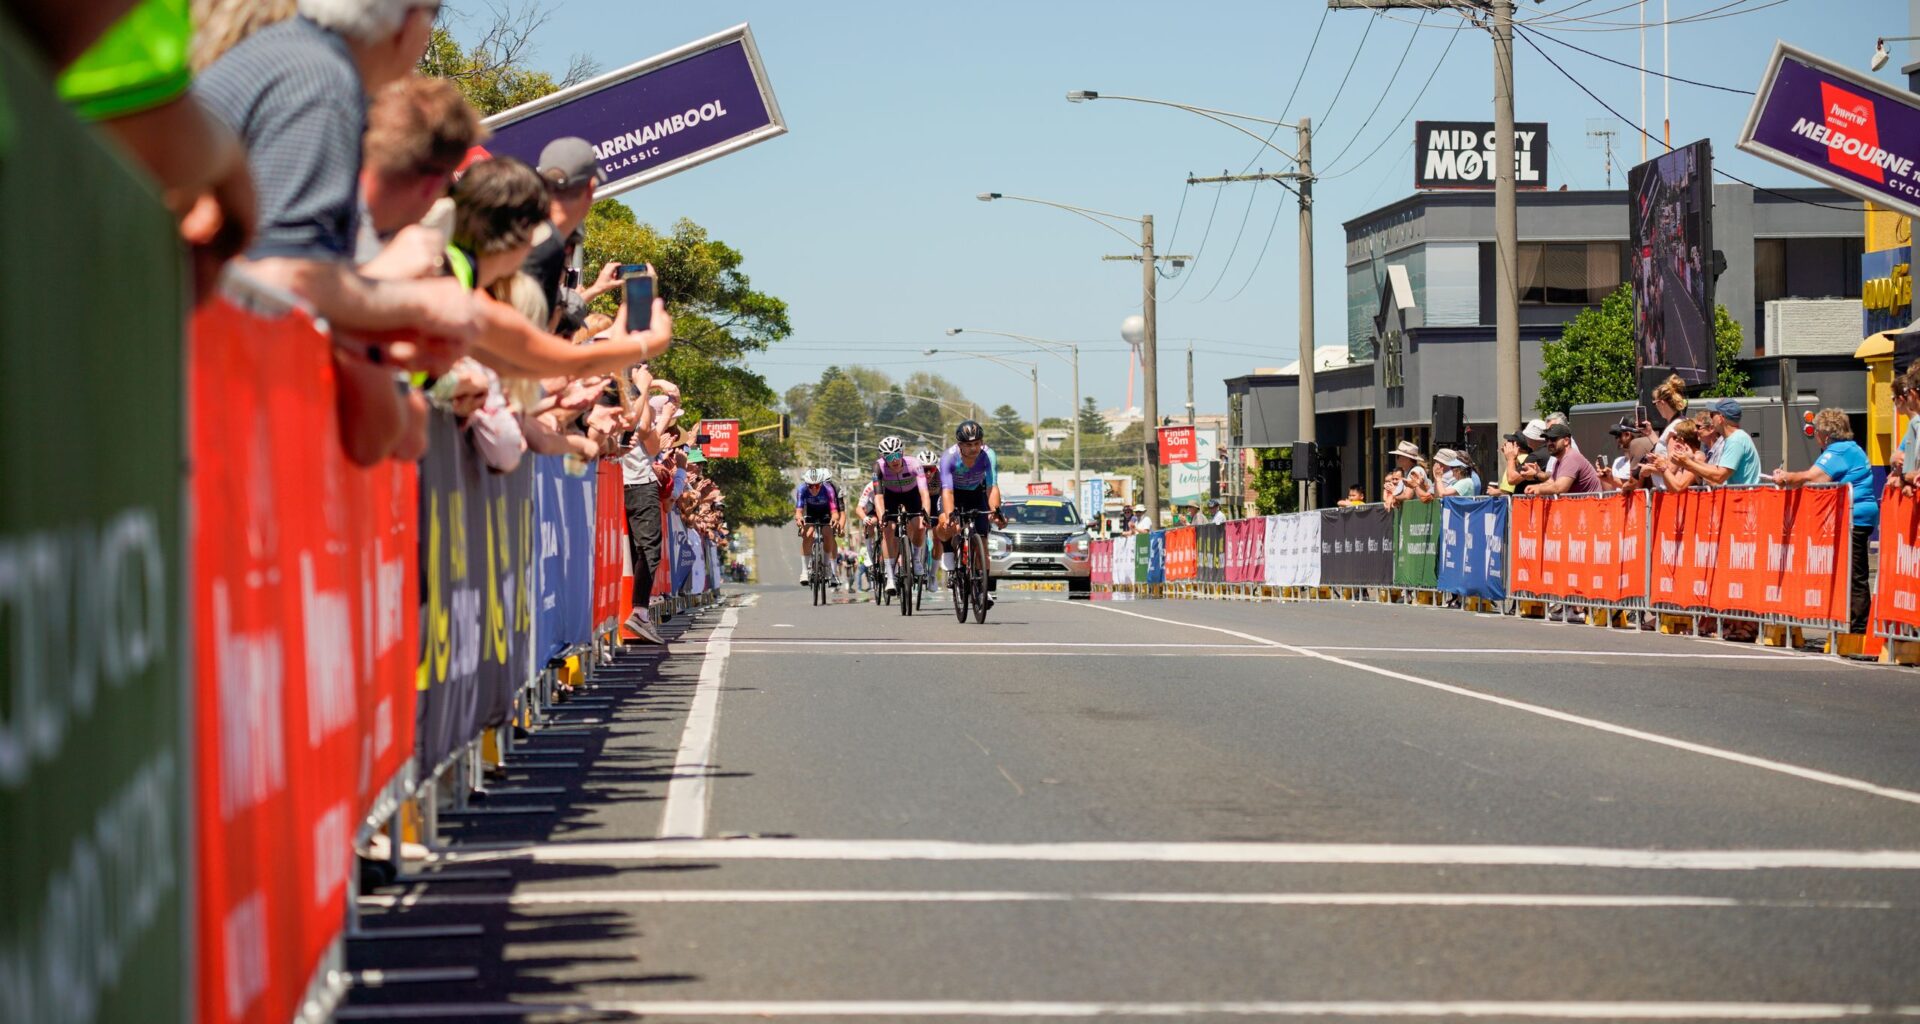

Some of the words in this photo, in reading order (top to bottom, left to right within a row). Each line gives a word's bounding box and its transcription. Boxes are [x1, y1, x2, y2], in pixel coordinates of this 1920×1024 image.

[1428, 130, 1478, 151] MID
[1483, 130, 1536, 151] CY
[1791, 117, 1914, 178] MELBOURNE
[605, 146, 660, 172] CLASSIC
[1164, 429, 1190, 438] Finish
[1167, 437, 1189, 446] 50m
